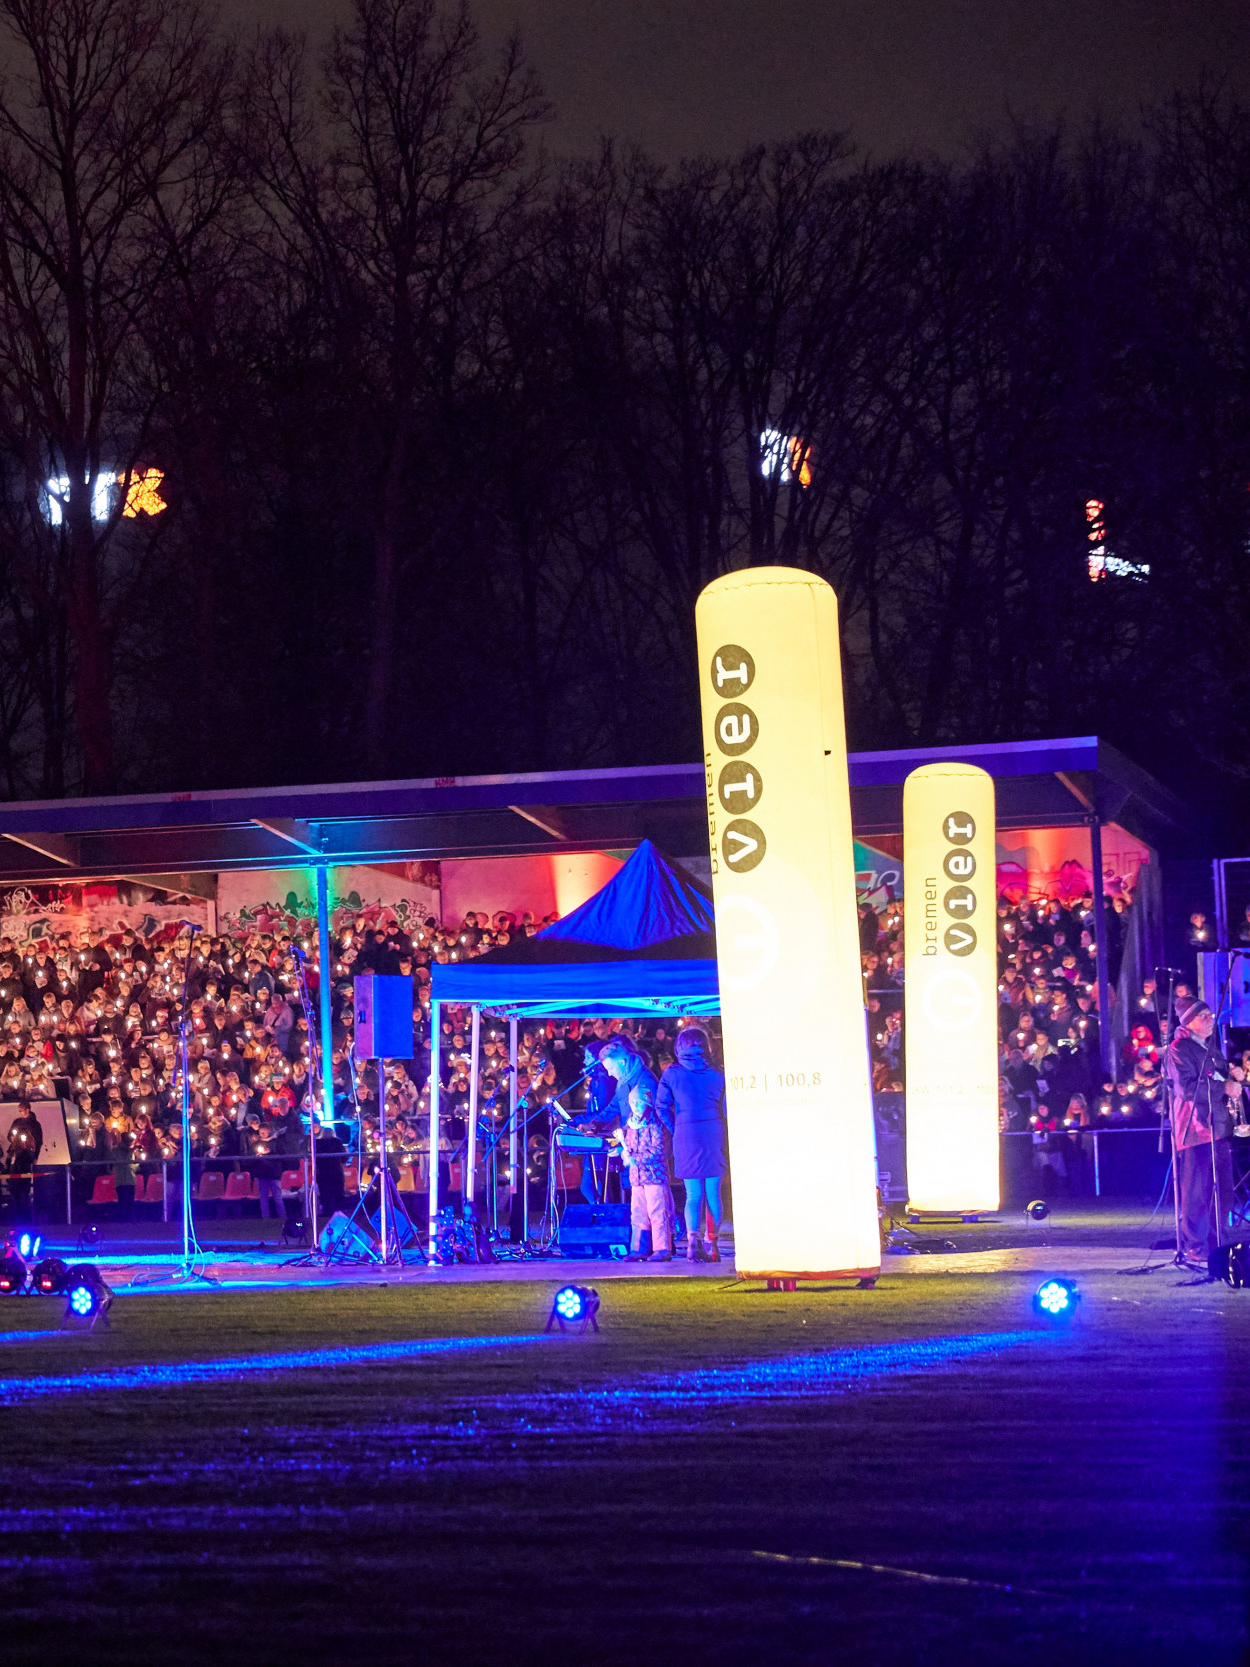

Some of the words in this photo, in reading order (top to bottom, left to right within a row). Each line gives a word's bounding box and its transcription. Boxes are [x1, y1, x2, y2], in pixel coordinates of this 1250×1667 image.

[715, 655, 759, 863] vier
[922, 875, 938, 957] bremen
[948, 816, 974, 951] vier
[776, 1071, 822, 1088] 100,8
